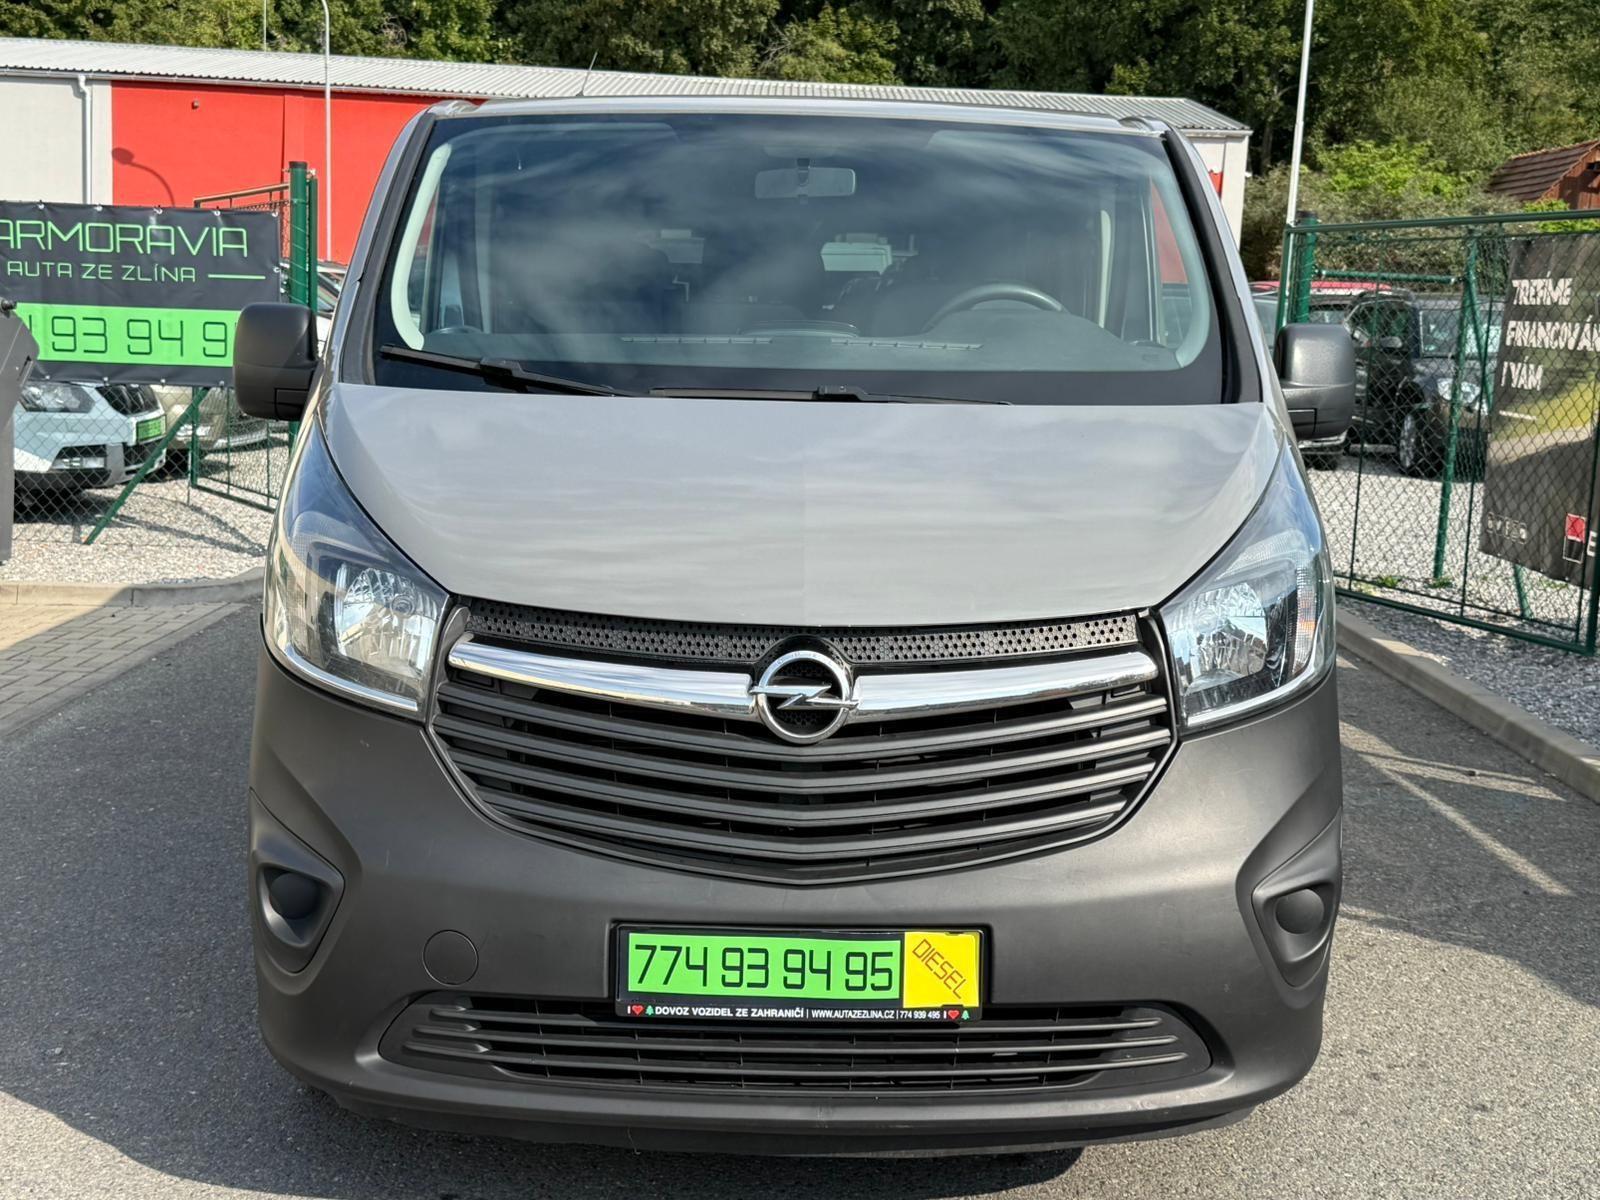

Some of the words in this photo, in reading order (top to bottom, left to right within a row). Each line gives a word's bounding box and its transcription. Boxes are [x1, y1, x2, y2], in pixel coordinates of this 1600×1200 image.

[7, 261, 72, 278] AUTA
[81, 264, 113, 280] ZE
[121, 263, 196, 283] ZLÍNA
[51, 316, 108, 354] 93
[127, 318, 184, 358] 94
[203, 321, 237, 358] 9
[1509, 355, 1544, 391] VÁM
[634, 943, 709, 988] 774
[720, 946, 770, 989] 93
[782, 948, 832, 991] 94
[844, 951, 894, 992] 95
[911, 938, 967, 999] DIESEL
[655, 1006, 690, 1016] DOVOZ
[691, 1006, 733, 1017] VOZIDEL
[735, 1008, 749, 1017] ZE
[750, 1006, 804, 1019] ZAHRANIČÍ
[811, 1009, 894, 1020] WWW.AUTAZEZLINA.CZ
[899, 1010, 913, 1019] 774
[913, 1010, 927, 1020] 939
[927, 1010, 941, 1020] 495
